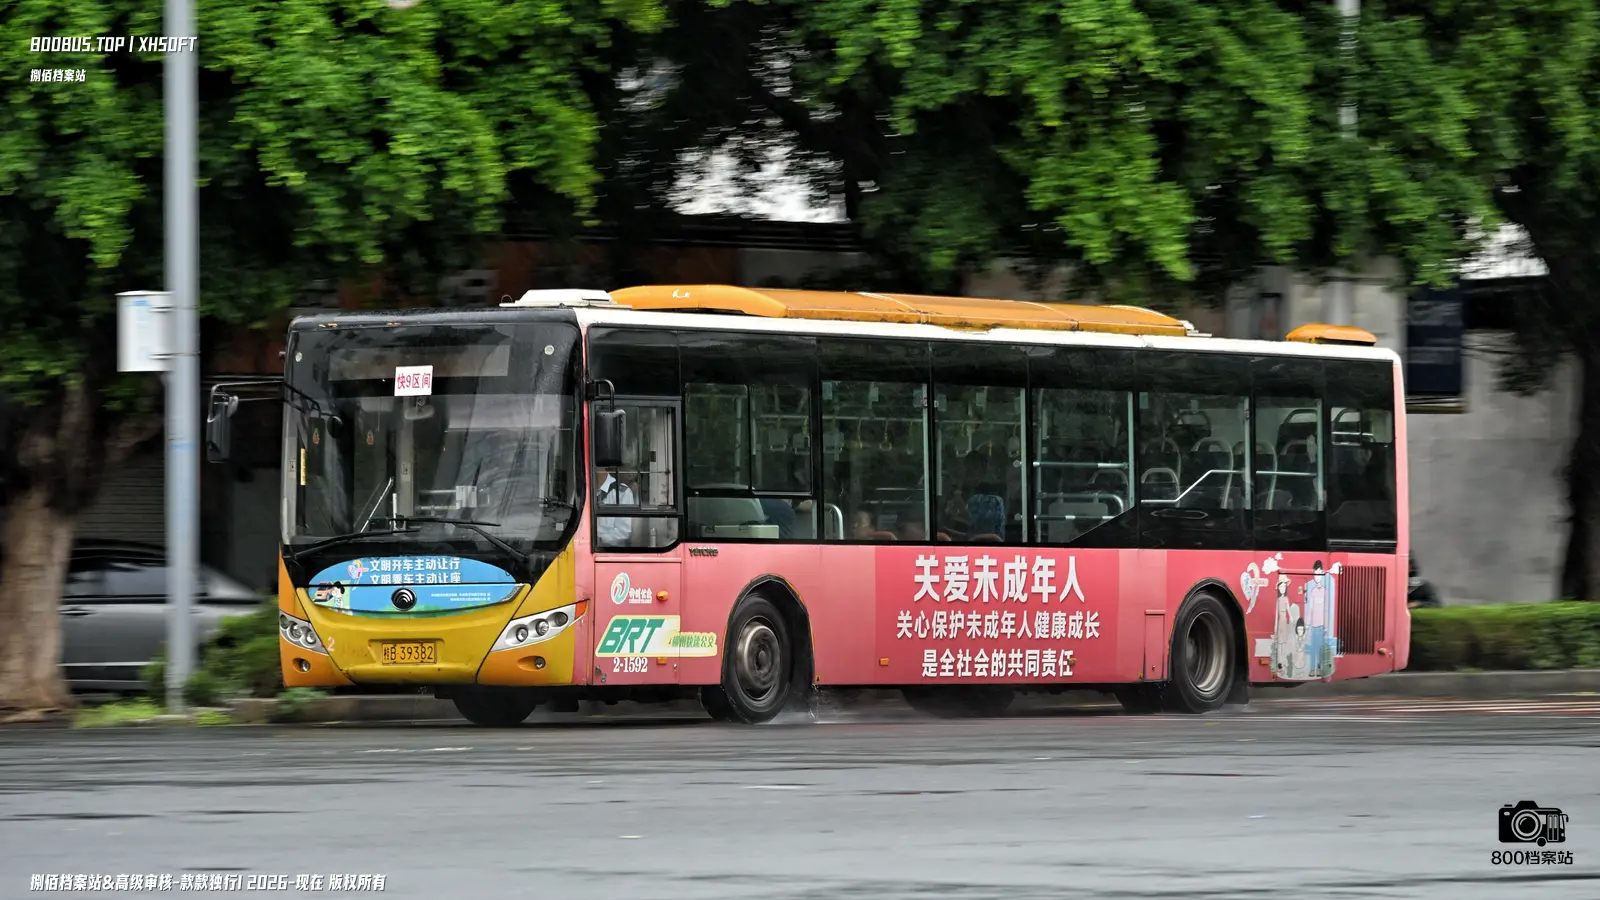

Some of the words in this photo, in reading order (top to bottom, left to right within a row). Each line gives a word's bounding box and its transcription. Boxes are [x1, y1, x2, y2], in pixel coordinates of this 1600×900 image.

[397, 372, 431, 390] 快9区间
[369, 557, 461, 572] 文明开车主动让行
[913, 554, 1085, 603] 关爱未成年人
[597, 618, 666, 654] BRT
[896, 610, 1101, 640] 关心保护未成年人健康成长
[327, 636, 336, 652] 2
[921, 648, 1074, 678] 是全社会的共同责任
